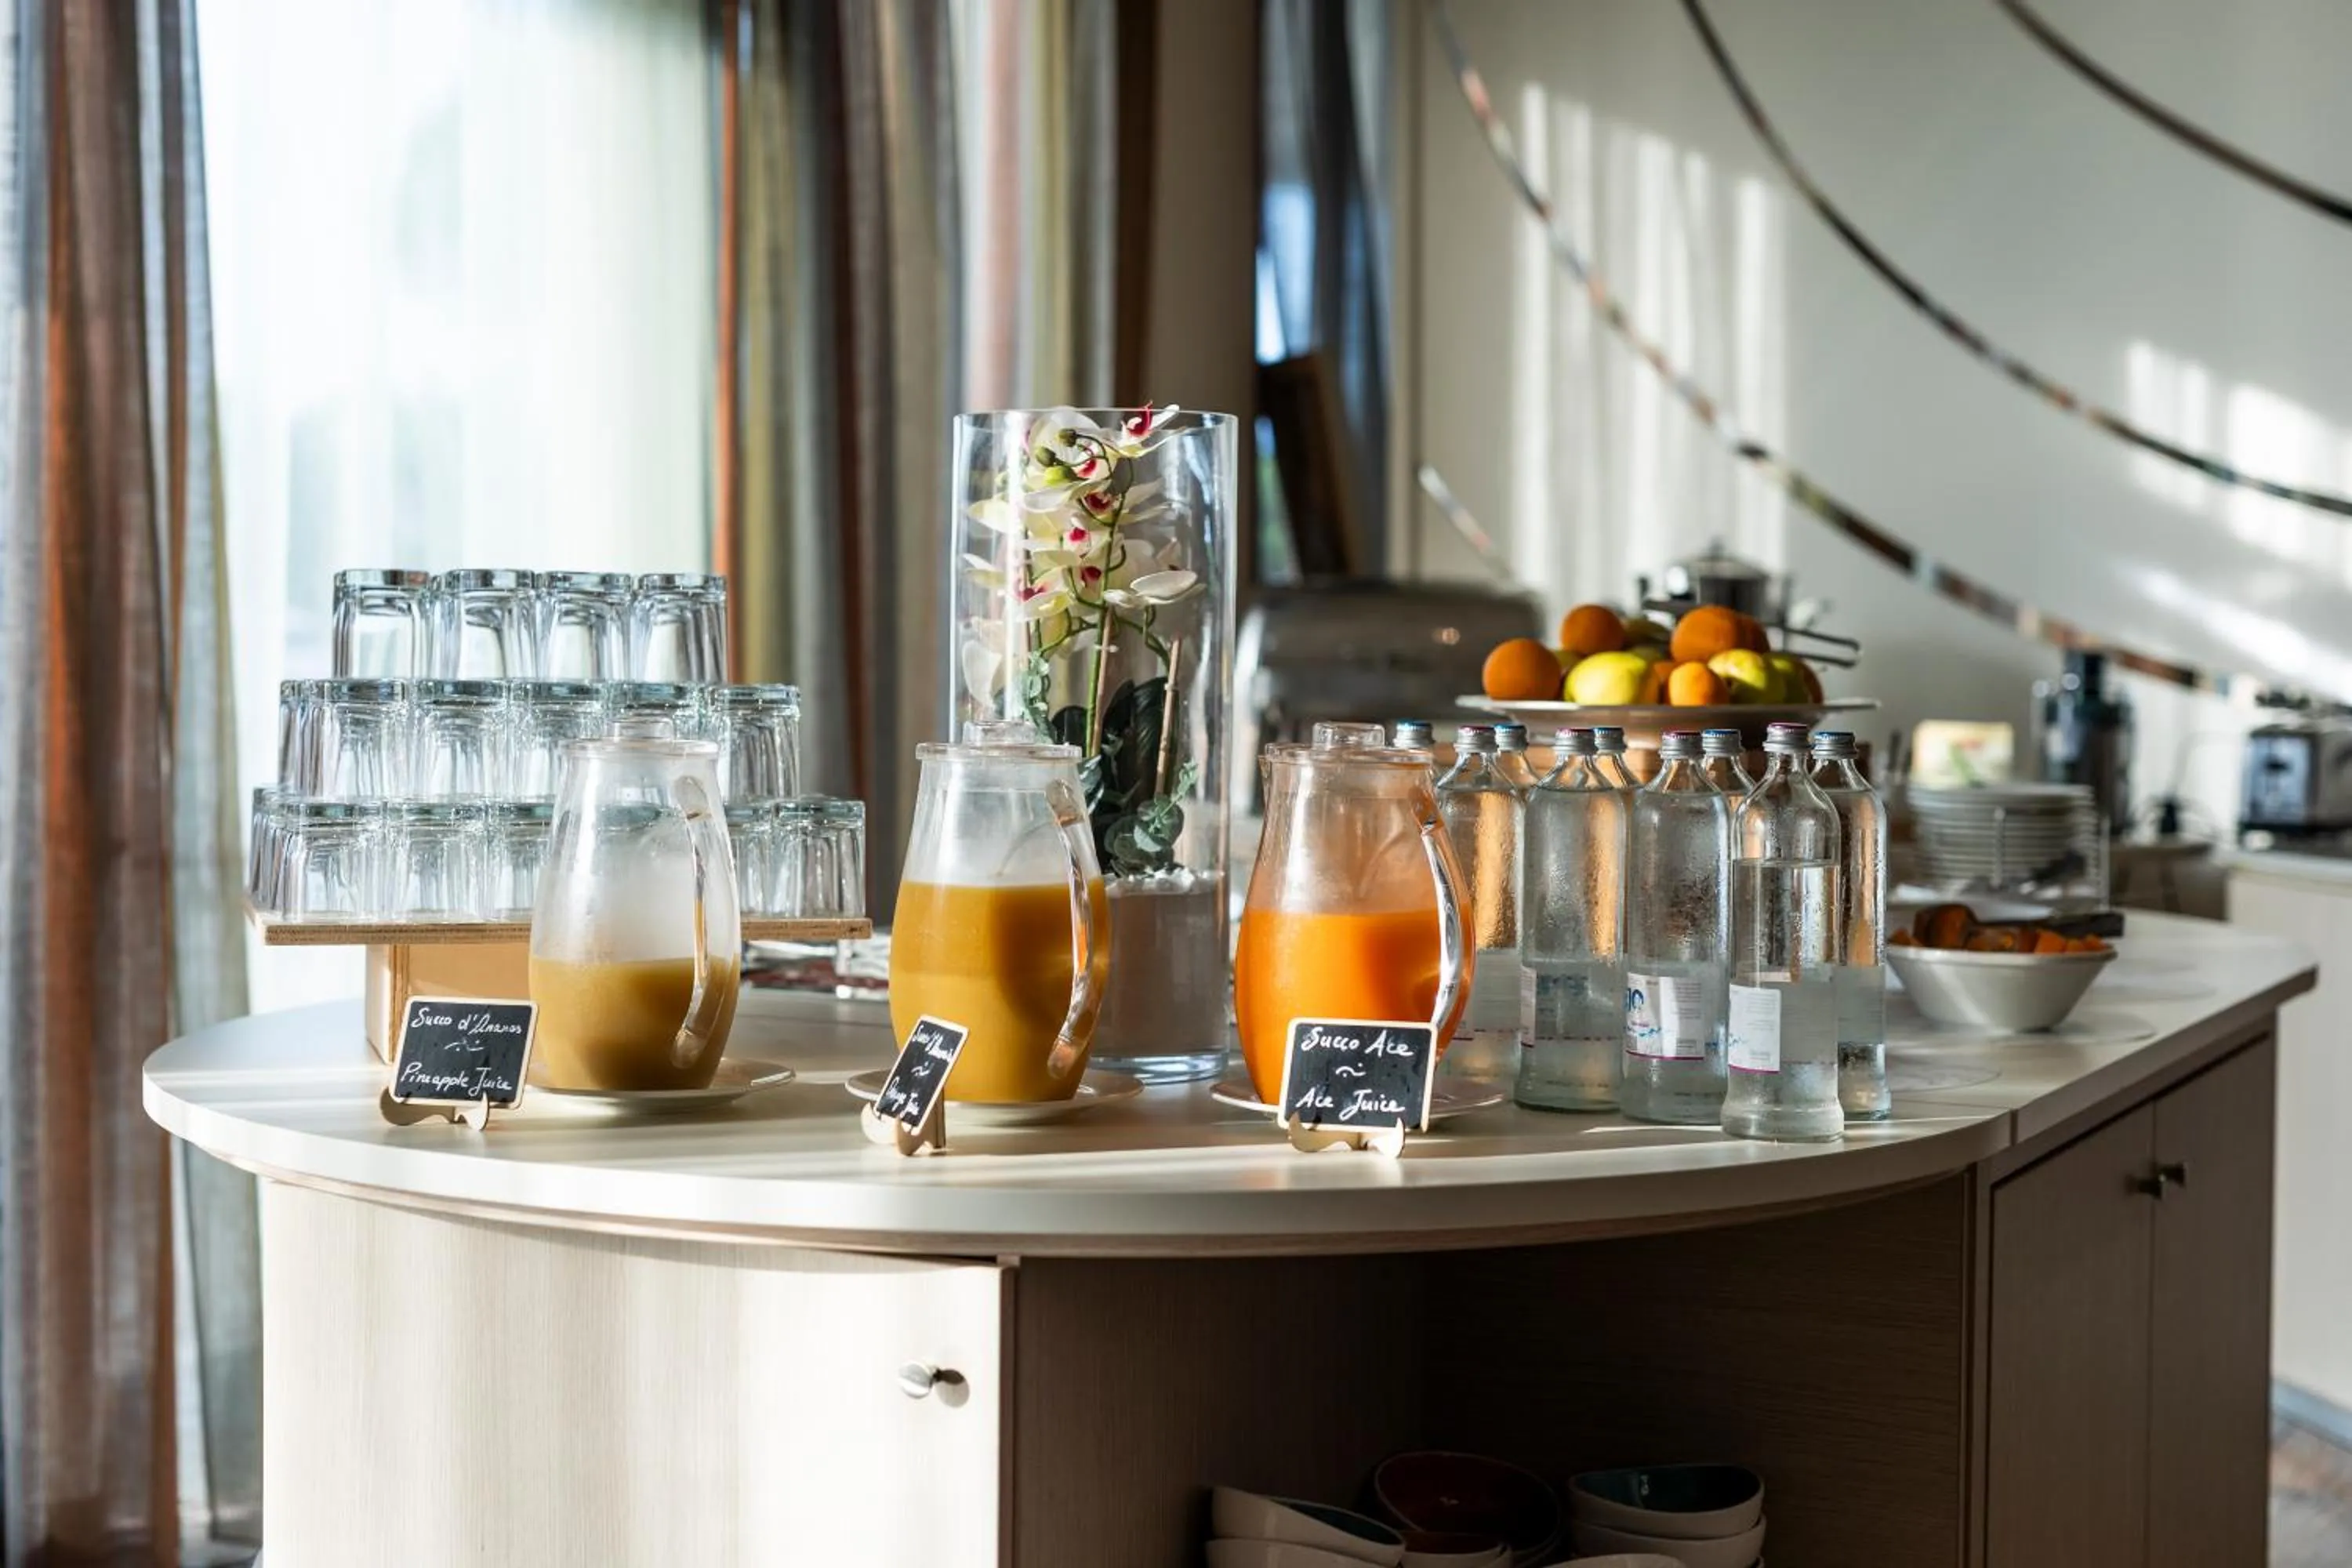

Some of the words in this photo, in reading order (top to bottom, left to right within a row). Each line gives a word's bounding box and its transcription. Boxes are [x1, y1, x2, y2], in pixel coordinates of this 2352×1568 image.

[411, 1007, 452, 1028] Succo
[1301, 1026, 1360, 1052] Succo
[1364, 1029, 1414, 1057] Ace
[401, 1062, 469, 1092] Pineapple
[468, 1067, 512, 1096] Juice
[1295, 1087, 1334, 1108] Ace
[1339, 1089, 1406, 1120] Juice
